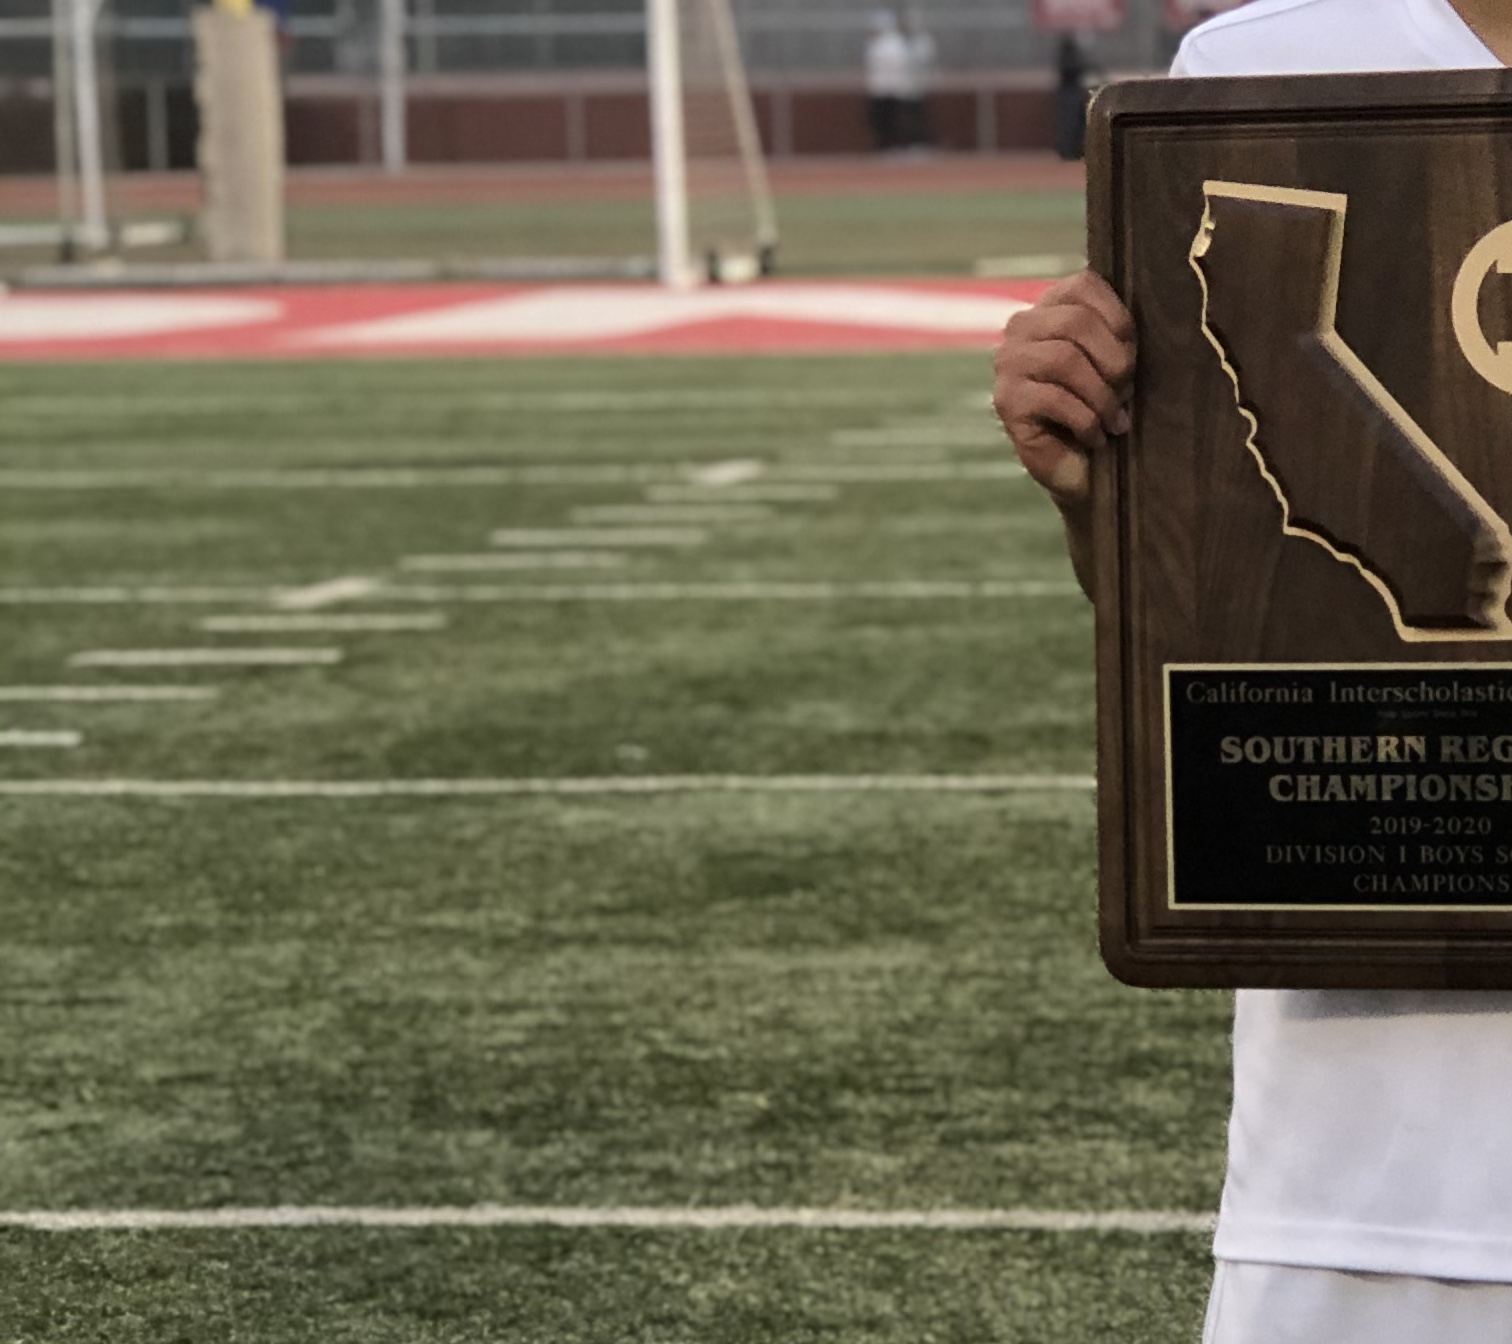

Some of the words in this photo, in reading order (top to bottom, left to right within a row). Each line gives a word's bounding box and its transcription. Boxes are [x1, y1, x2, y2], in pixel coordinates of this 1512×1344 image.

[1186, 680, 1314, 703] California
[1219, 735, 1427, 764] SOUTHERN
[1370, 816, 1492, 835] 2019-2020
[1266, 845, 1386, 864] DIVISION
[1420, 845, 1484, 864] BOYS
[1352, 873, 1511, 893] CHAMPIONS
